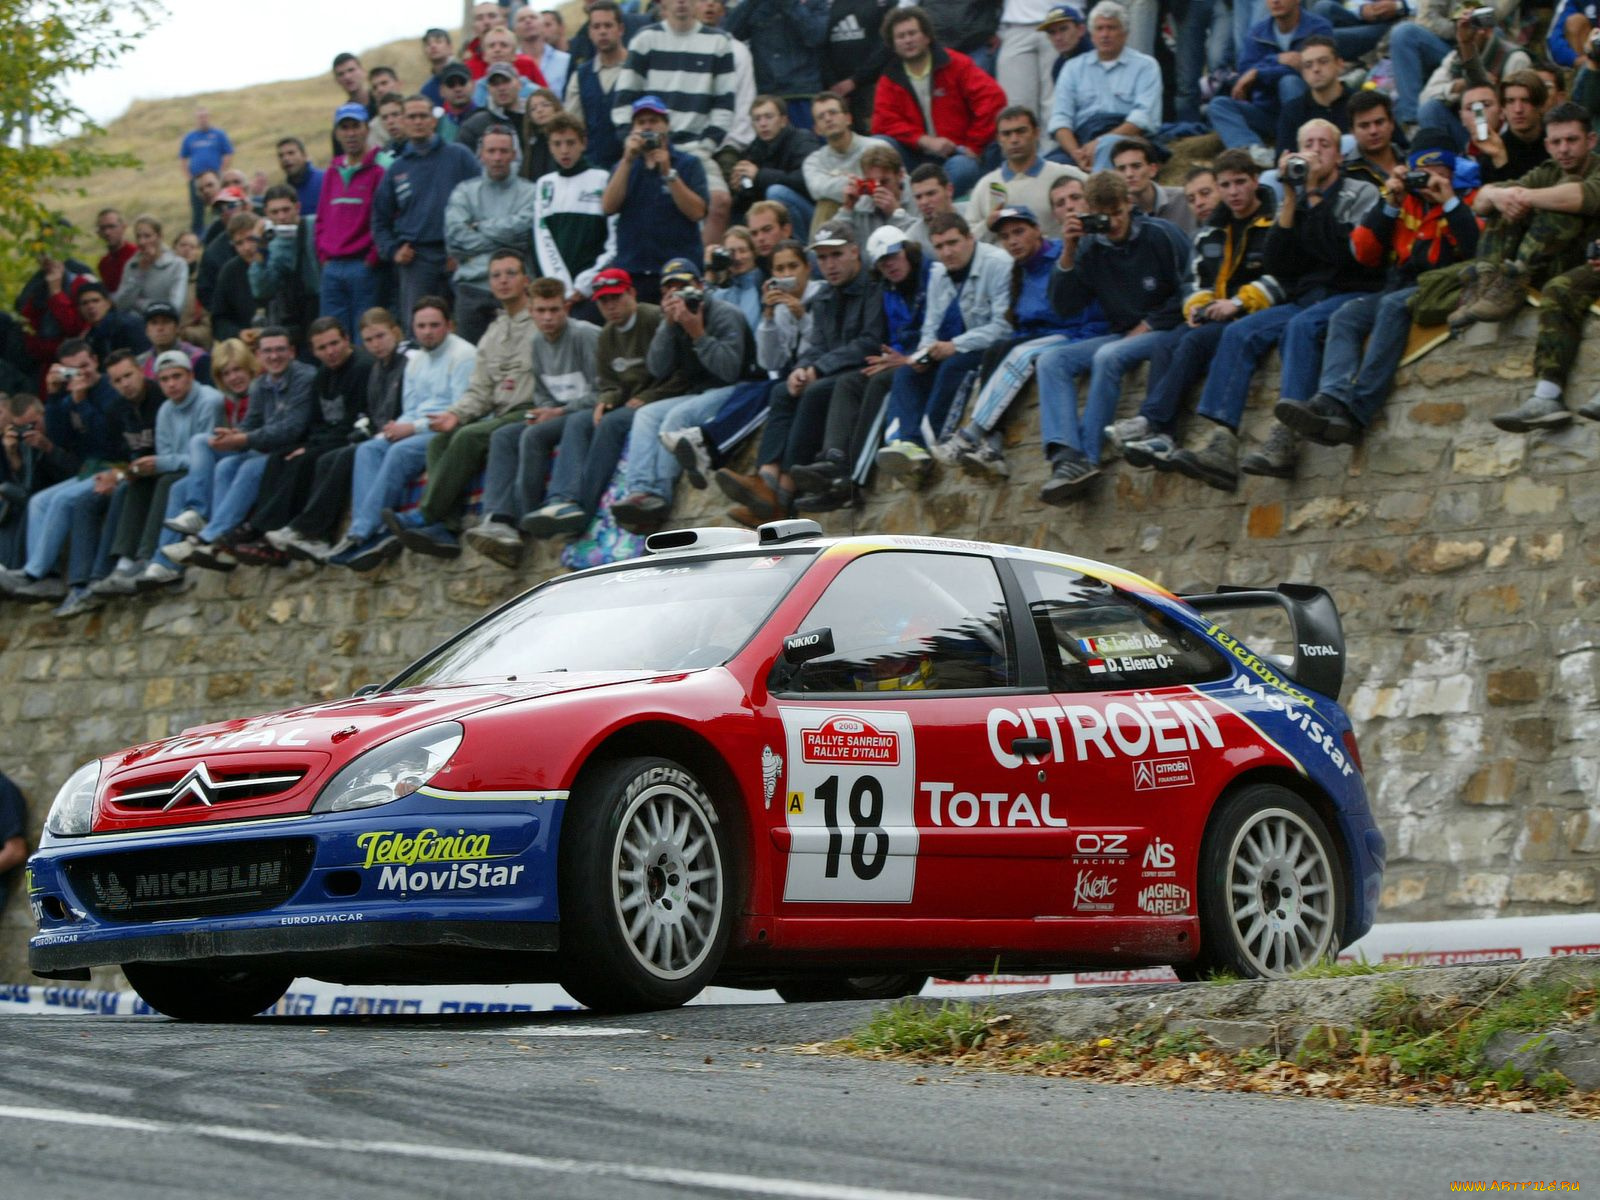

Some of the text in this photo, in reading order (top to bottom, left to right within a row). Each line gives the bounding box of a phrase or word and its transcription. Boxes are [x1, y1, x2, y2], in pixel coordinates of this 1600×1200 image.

[788, 634, 820, 650] NIKKO
[1106, 657, 1122, 672] D.
[1120, 655, 1158, 672] Elena
[838, 722, 859, 731] 2003
[986, 691, 1225, 769] CITROËN
[1232, 673, 1354, 777] MoviStar
[808, 734, 893, 748] RALLYE SANREMO
[813, 746, 890, 759] RALLYE D'ITALIA
[789, 794, 802, 812] A
[814, 774, 890, 881] 18
[135, 860, 282, 897] MICHELIN
[377, 863, 525, 892] MoviStar
[281, 912, 364, 925] EURODATACAR
